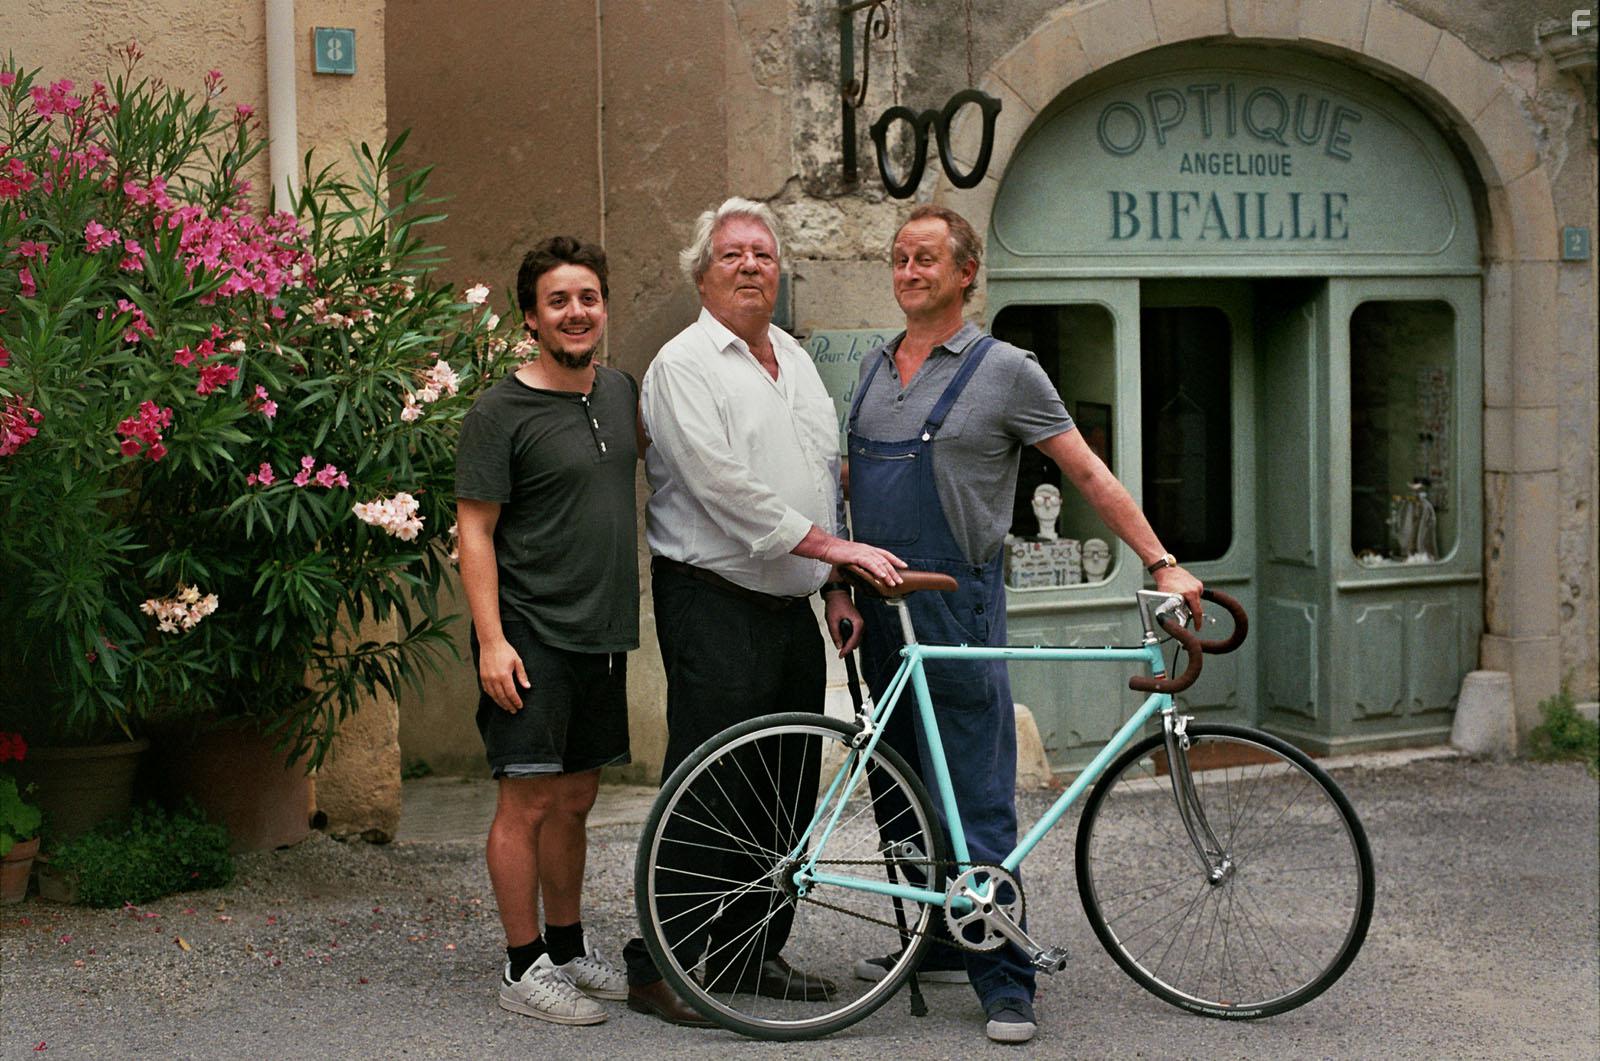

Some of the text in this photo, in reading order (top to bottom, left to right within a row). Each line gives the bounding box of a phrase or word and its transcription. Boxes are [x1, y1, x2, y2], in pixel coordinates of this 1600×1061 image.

[327, 37, 343, 61] 8
[1097, 81, 1363, 161] OPTIQUE
[1180, 152, 1292, 177] ANGELIQUE
[1107, 190, 1349, 241] BIFAILLE
[1570, 233, 1582, 252] 2
[811, 335, 845, 363] Pour
